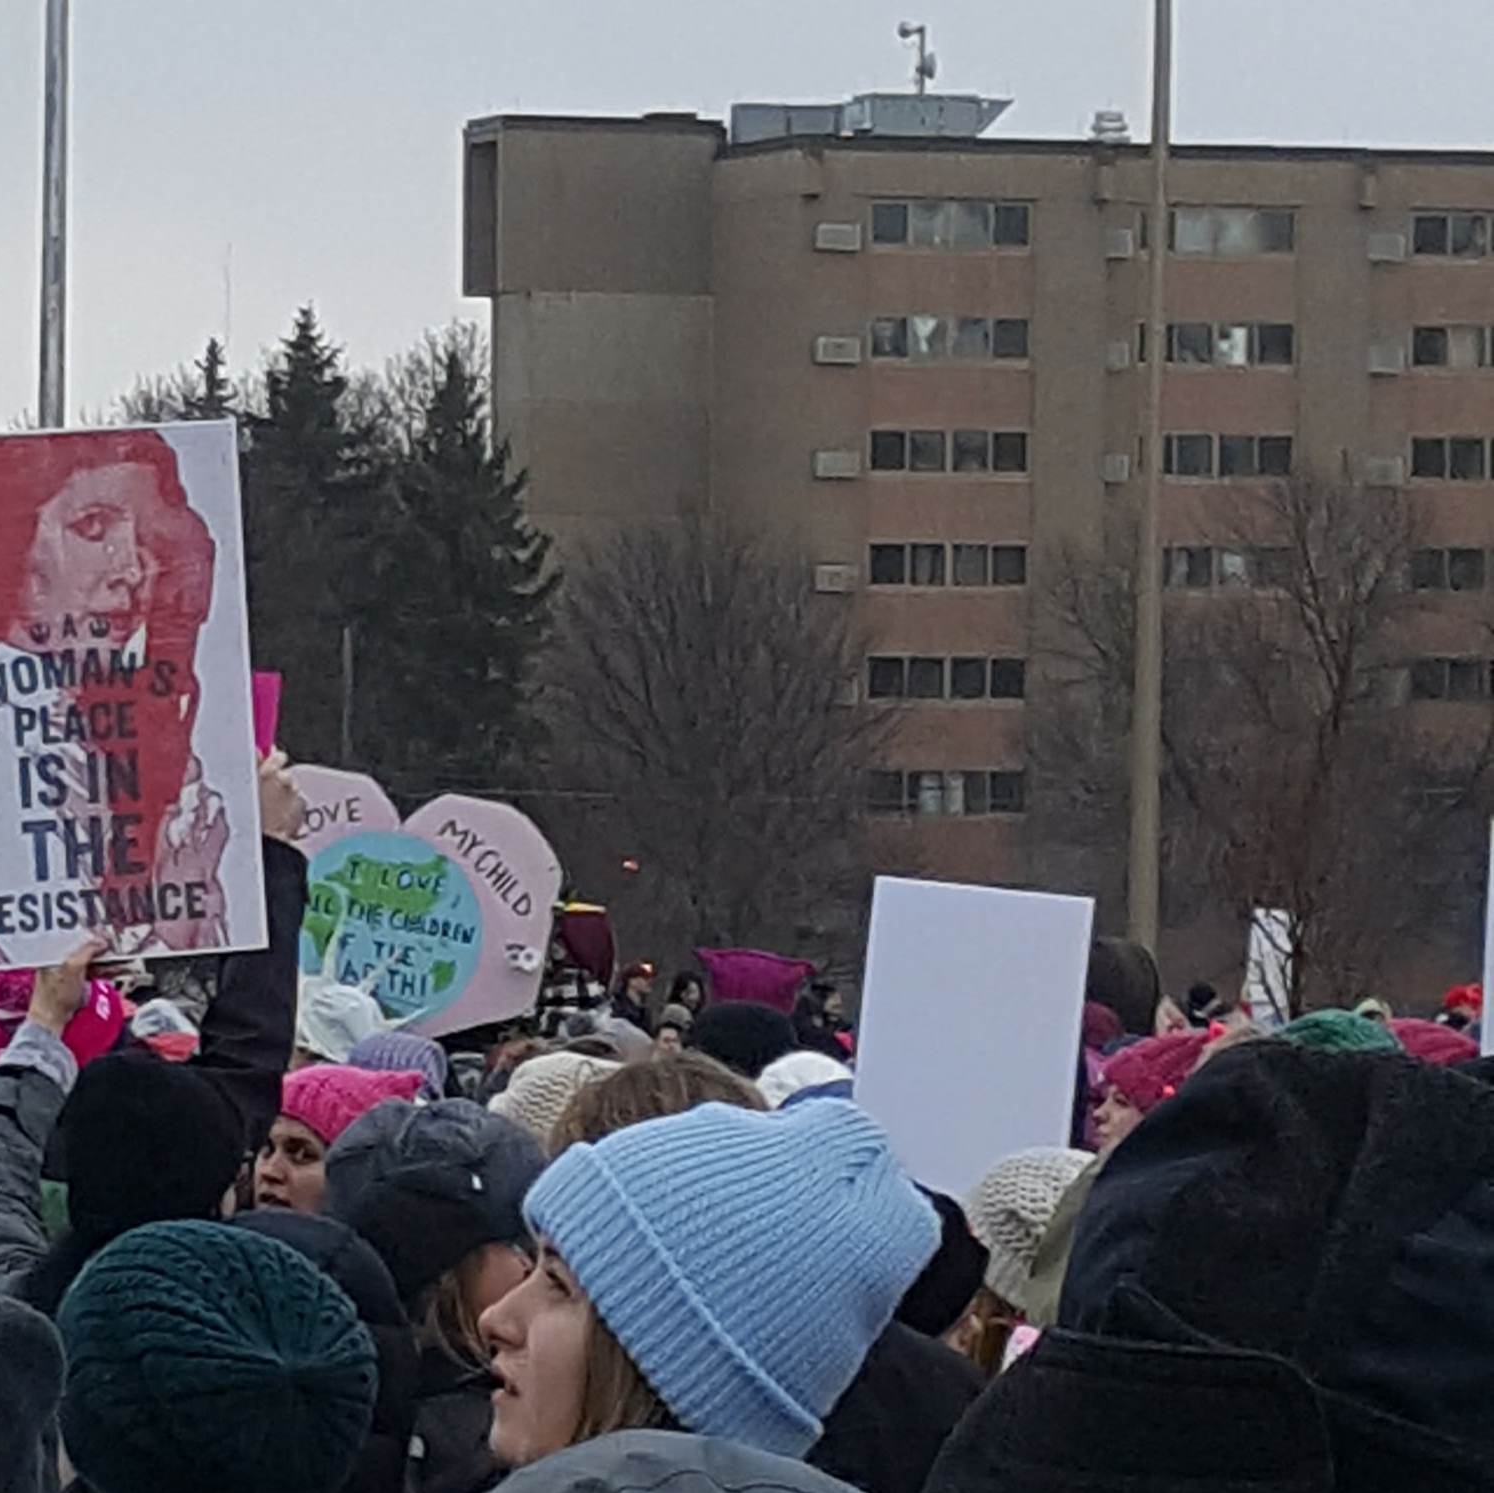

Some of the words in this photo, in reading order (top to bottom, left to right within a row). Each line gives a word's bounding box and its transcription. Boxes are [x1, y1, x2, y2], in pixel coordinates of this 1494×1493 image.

[62, 613, 79, 639] A
[14, 701, 138, 747] PLACE
[18, 753, 68, 810] IS
[86, 748, 141, 805] IN
[21, 814, 146, 882] THE
[436, 819, 485, 858] MY
[473, 849, 532, 917] CHILD
[380, 865, 448, 897] LOVE
